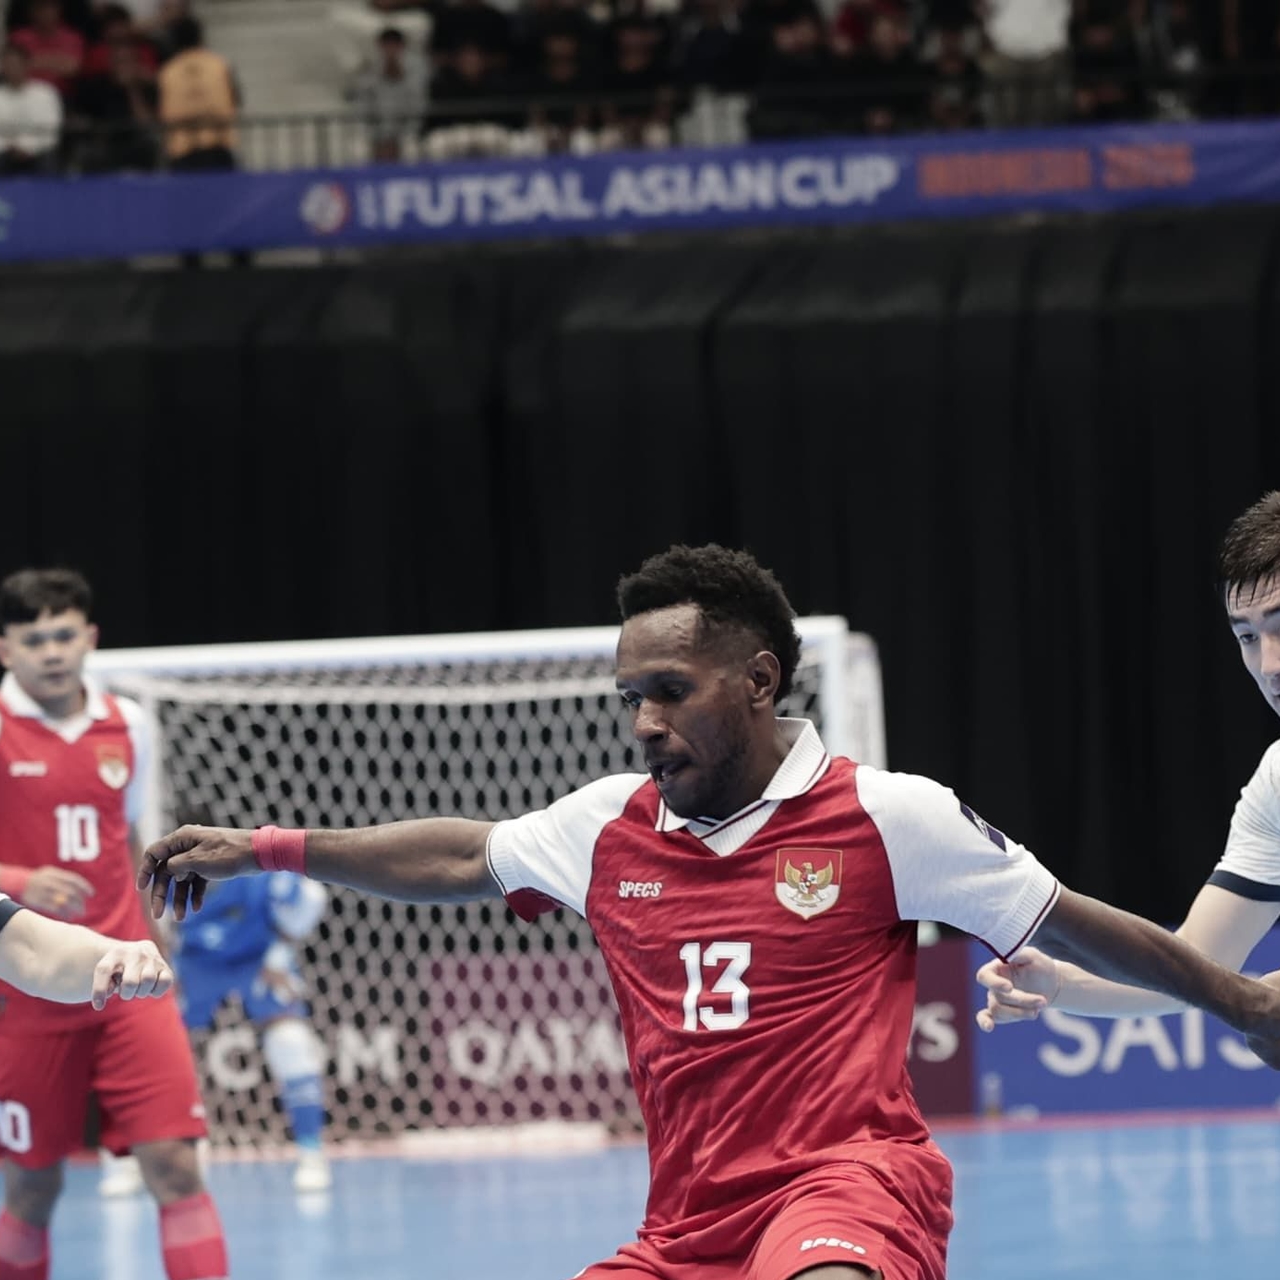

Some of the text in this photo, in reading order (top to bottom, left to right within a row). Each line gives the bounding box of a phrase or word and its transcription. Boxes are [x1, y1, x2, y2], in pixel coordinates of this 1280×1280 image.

[381, 174, 593, 230] FUTSAL
[600, 162, 777, 218] ASIAN
[779, 154, 900, 208] CUP
[54, 804, 101, 862] 10
[618, 880, 662, 898] SPECS
[679, 942, 752, 1031] 13
